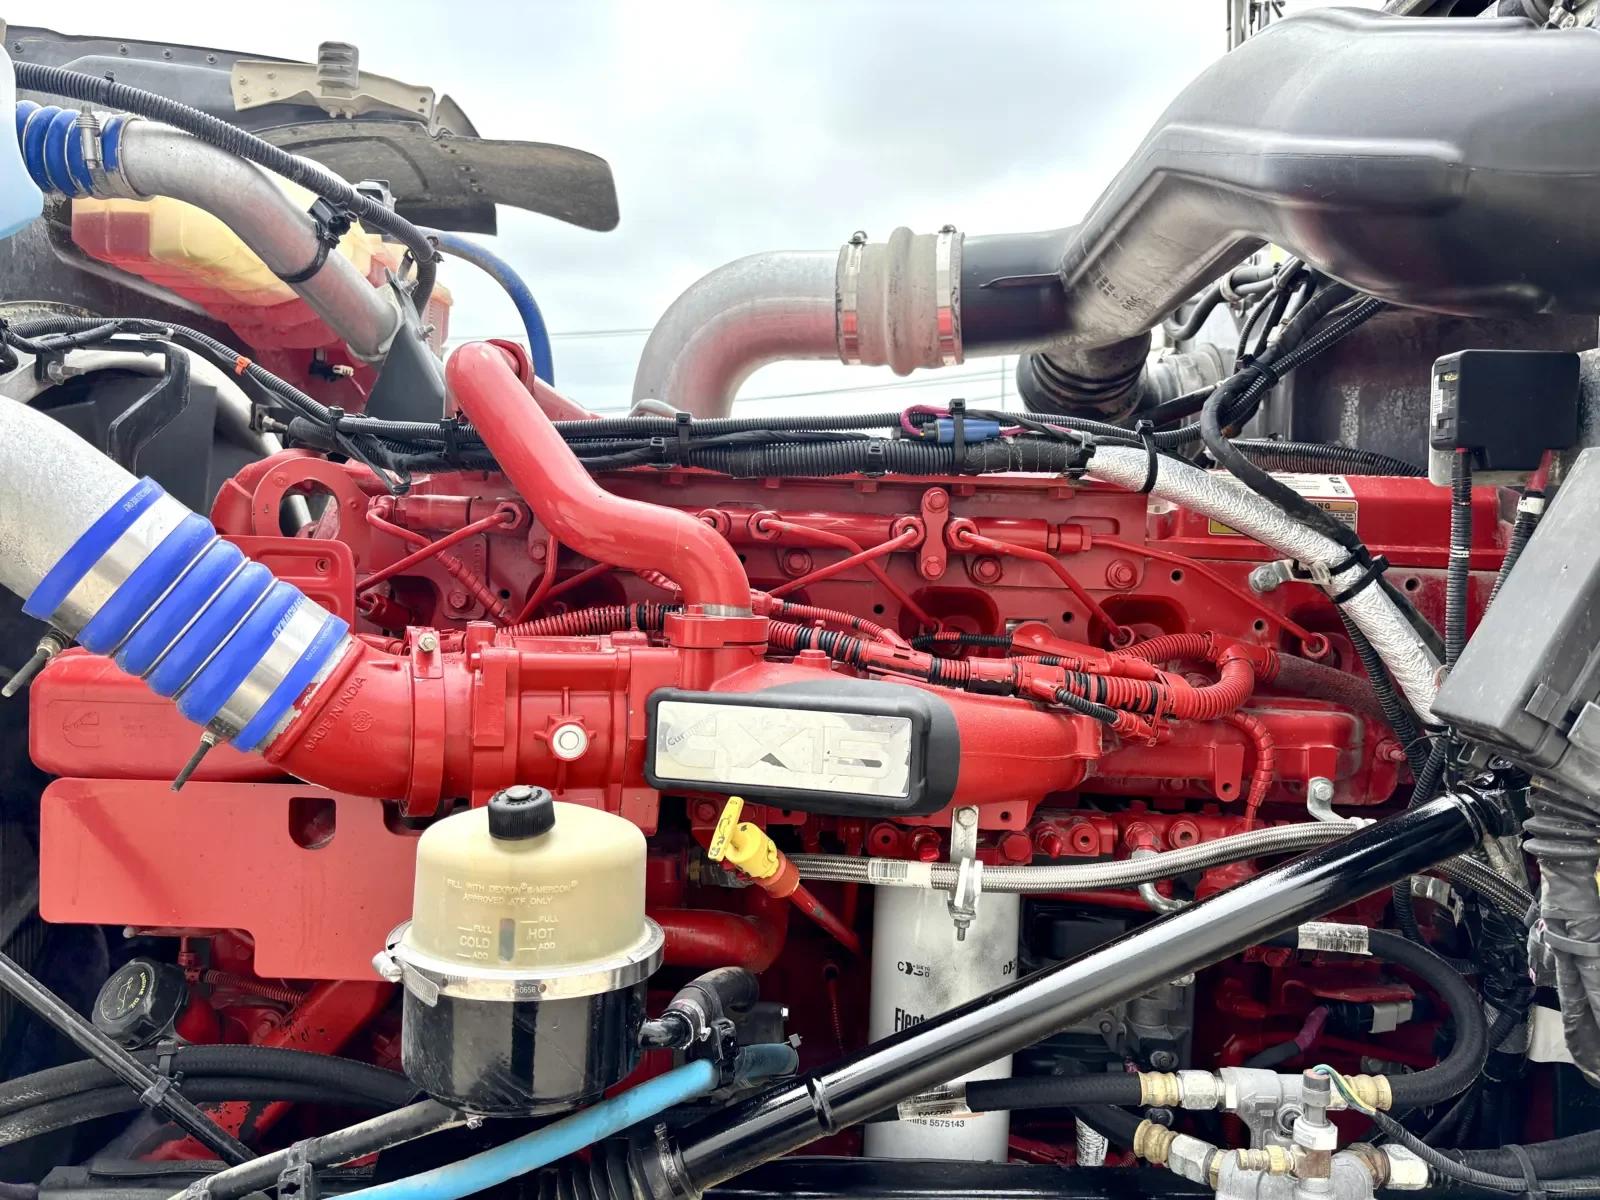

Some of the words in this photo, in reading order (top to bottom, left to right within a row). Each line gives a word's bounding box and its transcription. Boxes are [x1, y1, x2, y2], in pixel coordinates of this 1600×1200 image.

[304, 721, 331, 752] MADE
[330, 705, 345, 721] IN
[341, 676, 367, 708] INDIA
[539, 915, 560, 923] FULL
[473, 924, 492, 934] FULL
[528, 927, 555, 939] HOT
[459, 935, 490, 948] COLD
[538, 942, 556, 951] ADD
[472, 951, 489, 960] ADD
[929, 1119, 965, 1128] 5575143
